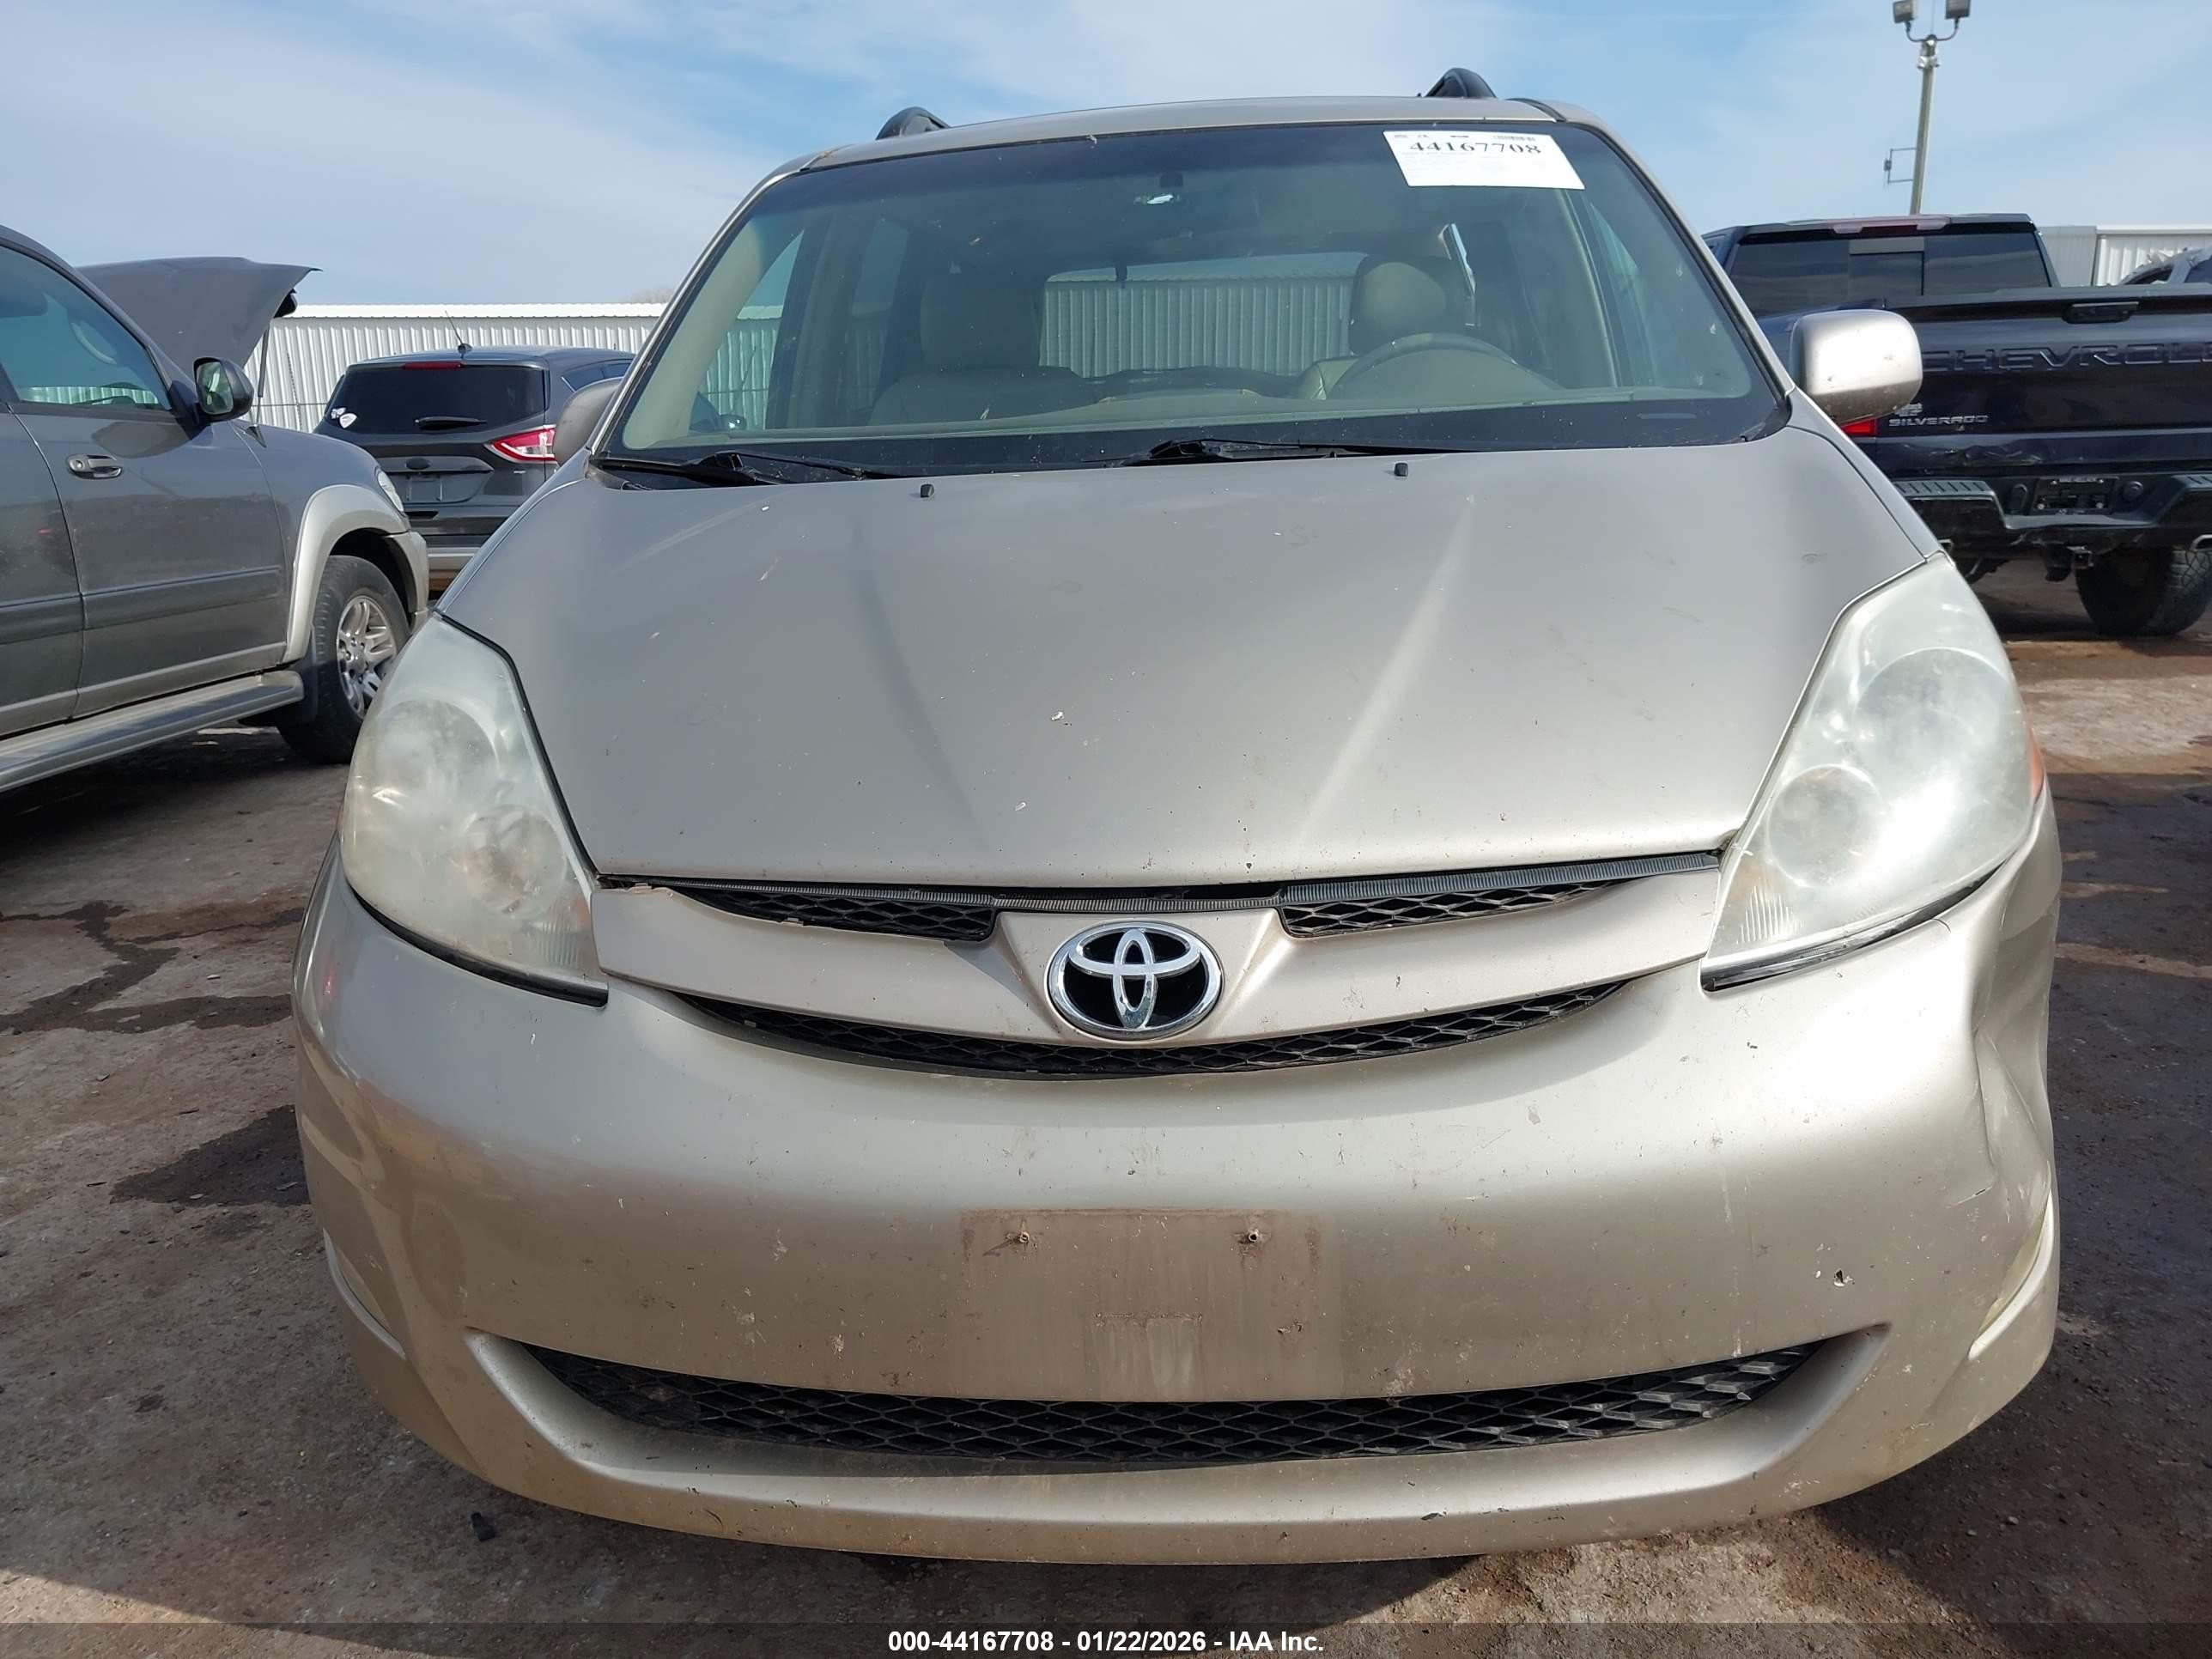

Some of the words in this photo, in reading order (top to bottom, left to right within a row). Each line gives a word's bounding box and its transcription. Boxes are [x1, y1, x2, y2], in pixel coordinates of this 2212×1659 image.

[1410, 142, 1542, 155] 44167708
[1922, 343, 2212, 372] CHEVROL
[1888, 415, 1989, 427] SILVERADO
